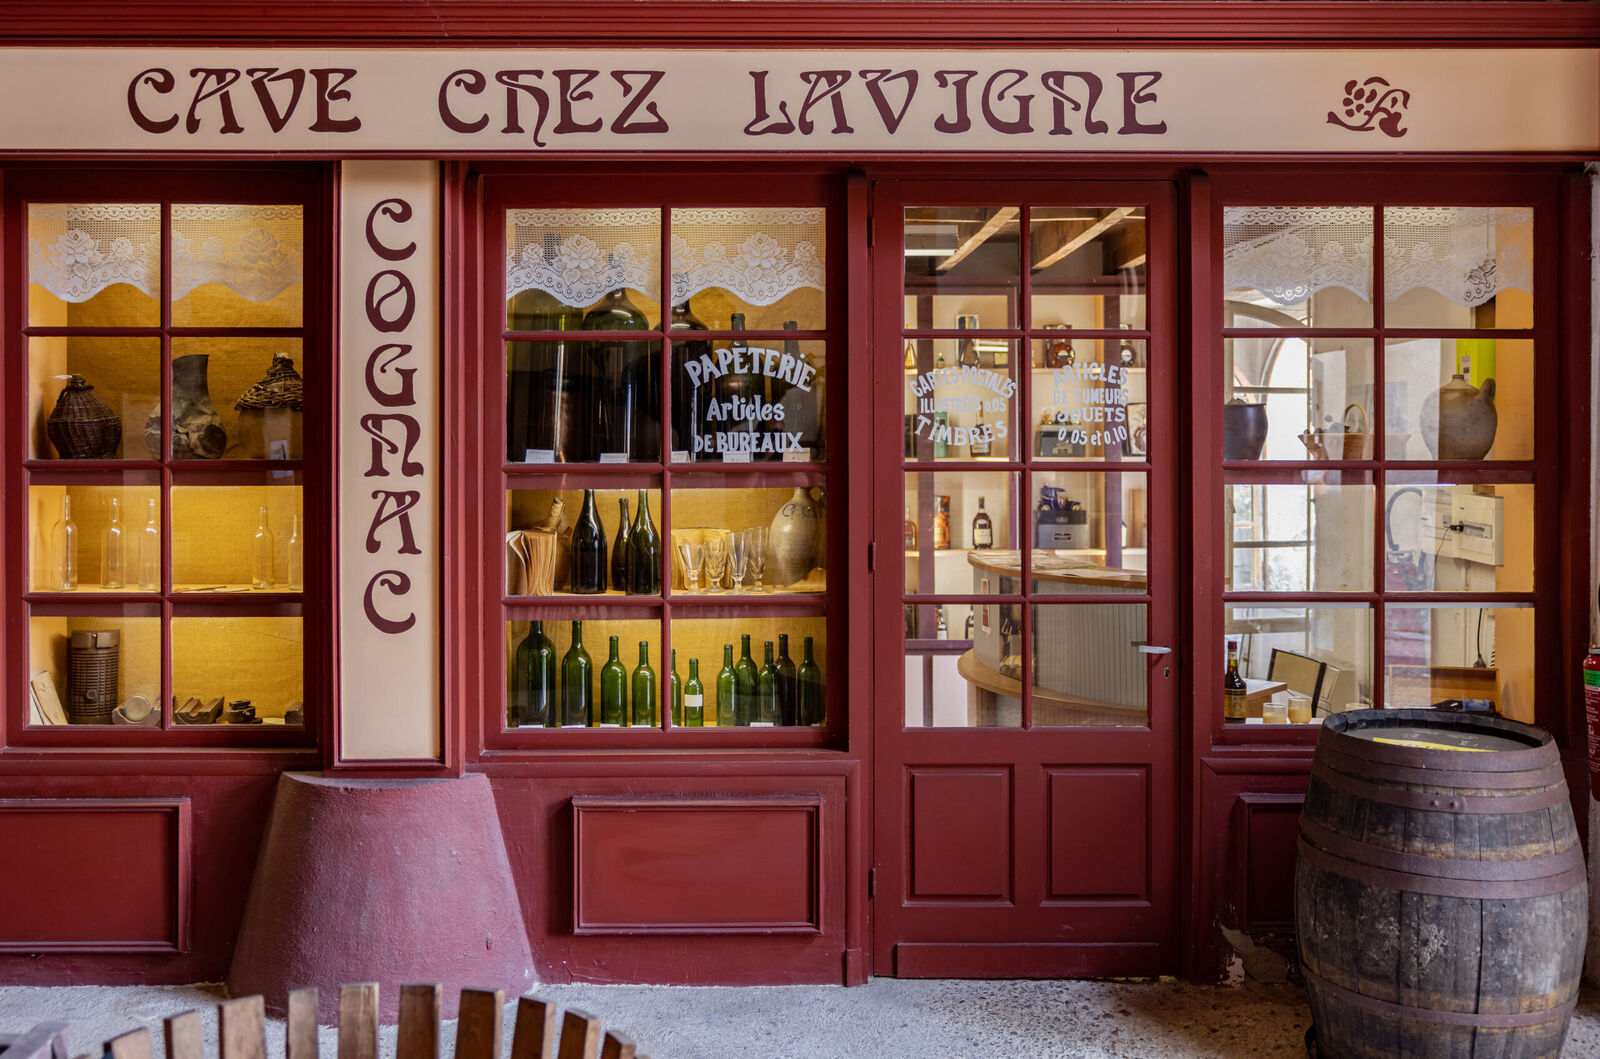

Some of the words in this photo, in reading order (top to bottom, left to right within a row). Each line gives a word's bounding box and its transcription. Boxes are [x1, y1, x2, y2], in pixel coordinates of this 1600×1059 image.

[128, 68, 362, 135] CAVE
[439, 69, 669, 148] CHEZ
[744, 69, 1168, 136] LAVIGNE
[684, 347, 817, 393] PAPETERIE
[909, 366, 960, 398] CARTES
[961, 364, 1017, 399] POSTALES
[1053, 361, 1129, 388] ARTICLES
[706, 394, 786, 422] Articles
[920, 392, 982, 414] ILLUSTRÉES
[1053, 389, 1068, 405] DE
[1074, 388, 1129, 405] FUMEURS
[360, 198, 424, 635] COGNAC
[1056, 406, 1126, 423] JOUETS
[694, 434, 713, 453] DE
[716, 431, 804, 453] BUREAUX
[914, 414, 1008, 446] TIMBRES
[1090, 430, 1102, 446] et
